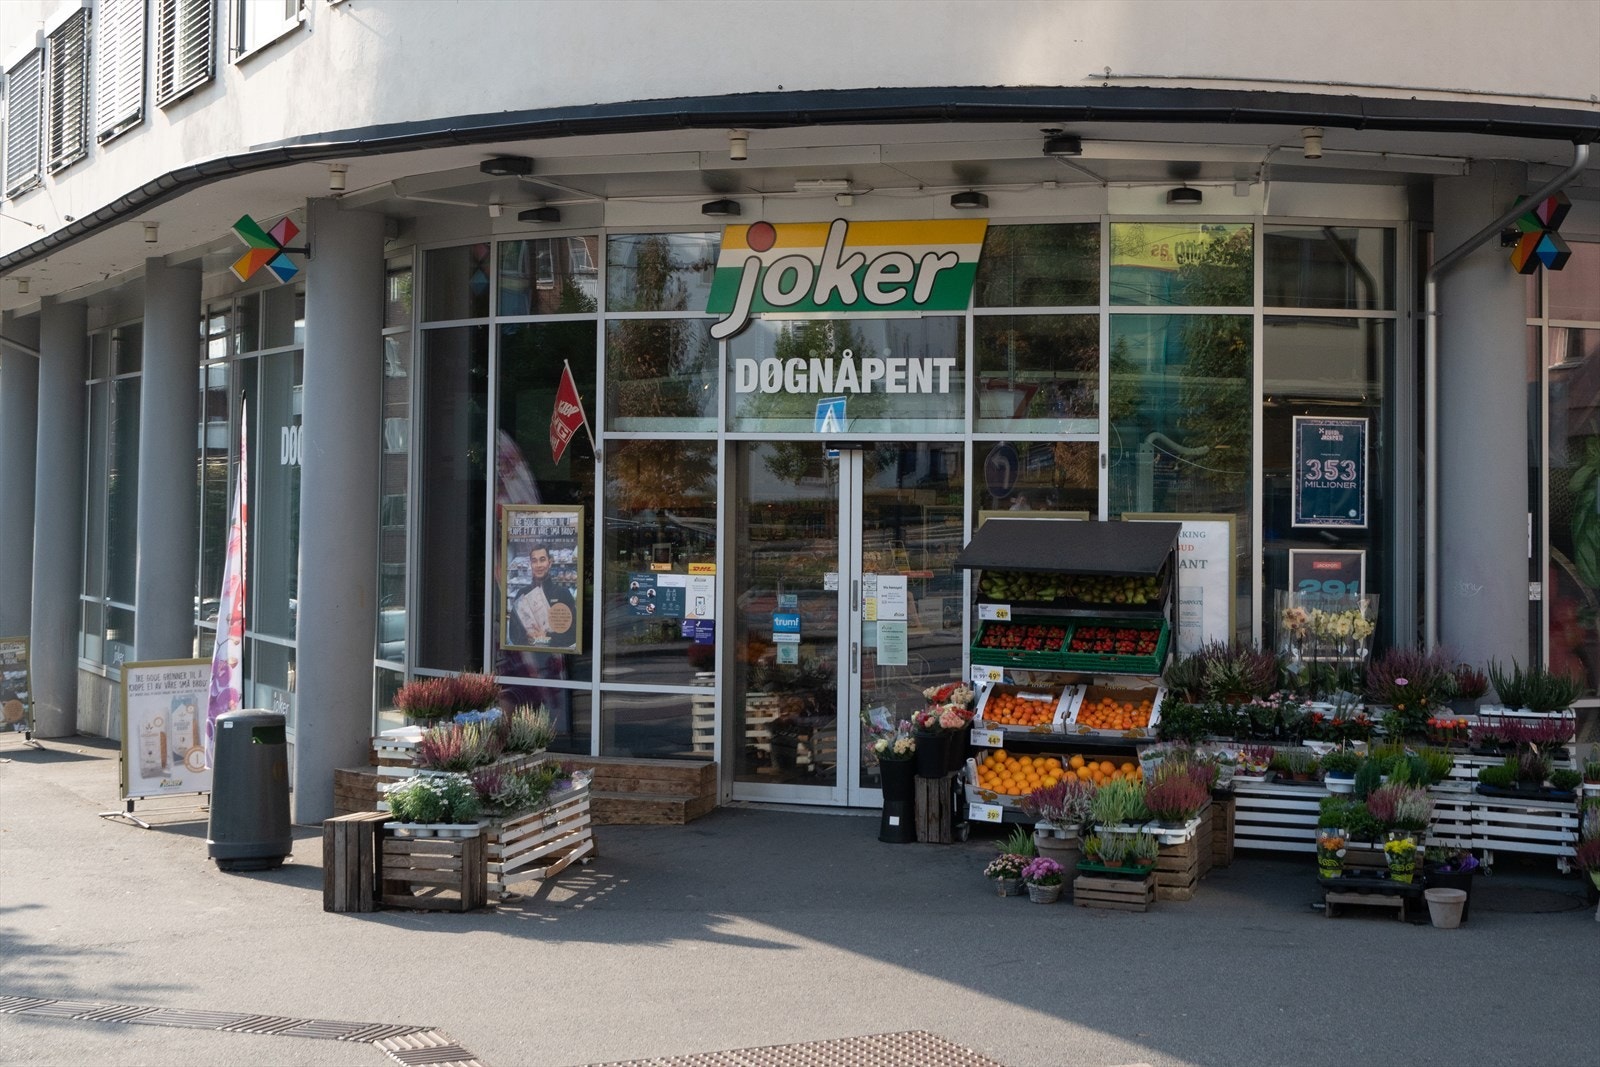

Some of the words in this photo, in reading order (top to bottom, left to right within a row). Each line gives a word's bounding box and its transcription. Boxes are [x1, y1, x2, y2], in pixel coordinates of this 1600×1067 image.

[709, 218, 959, 339] joker
[735, 349, 956, 394] DØGNÅPENT
[1305, 459, 1357, 481] 353
[1305, 481, 1357, 489] MILLIONER
[1298, 579, 1360, 600] 291
[774, 617, 800, 626] trumf
